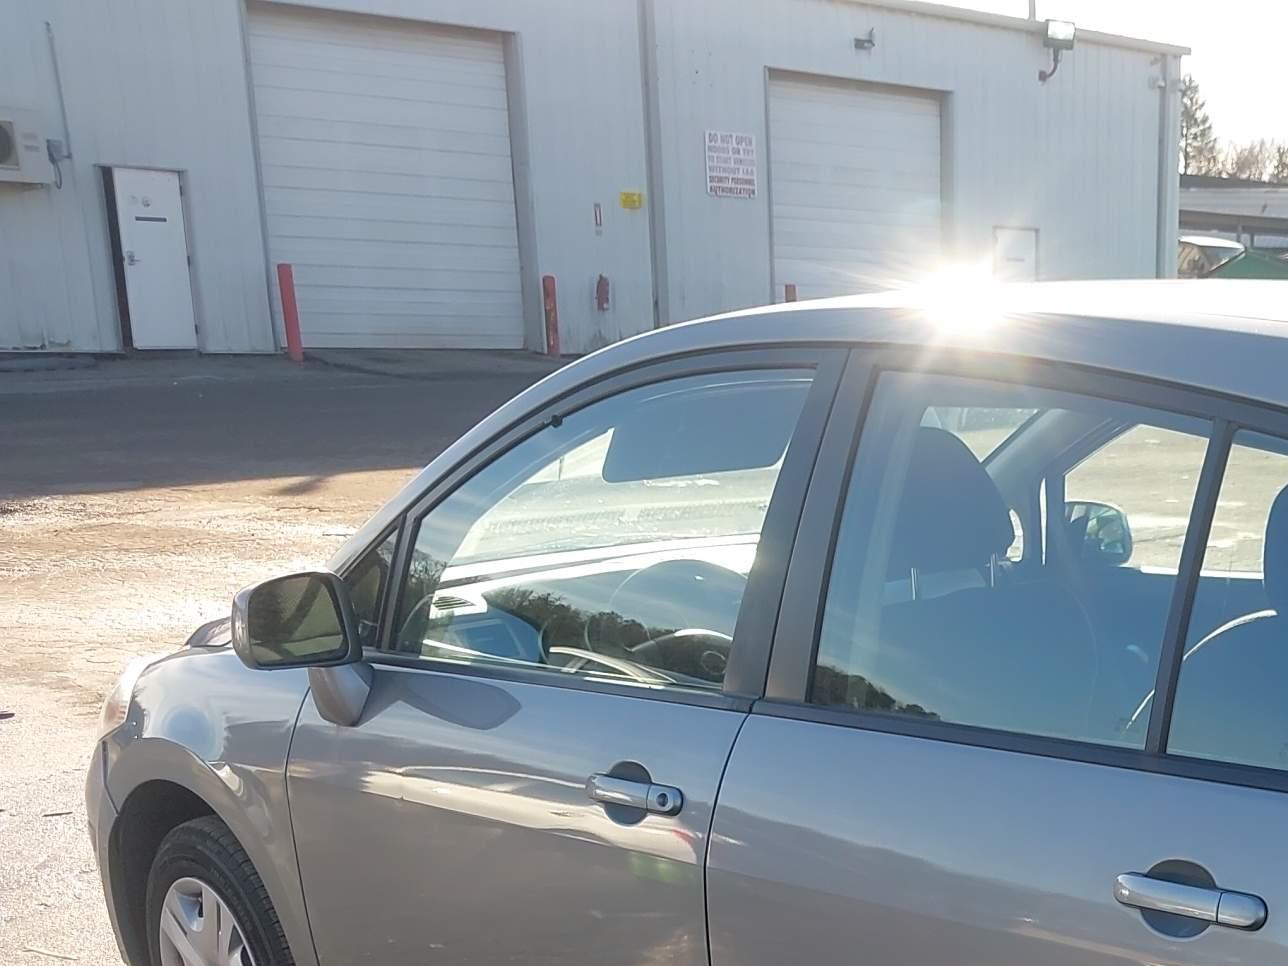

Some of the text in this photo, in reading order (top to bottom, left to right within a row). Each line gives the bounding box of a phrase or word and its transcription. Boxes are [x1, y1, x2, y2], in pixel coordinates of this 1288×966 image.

[708, 132, 753, 147] DO NOT OPEN
